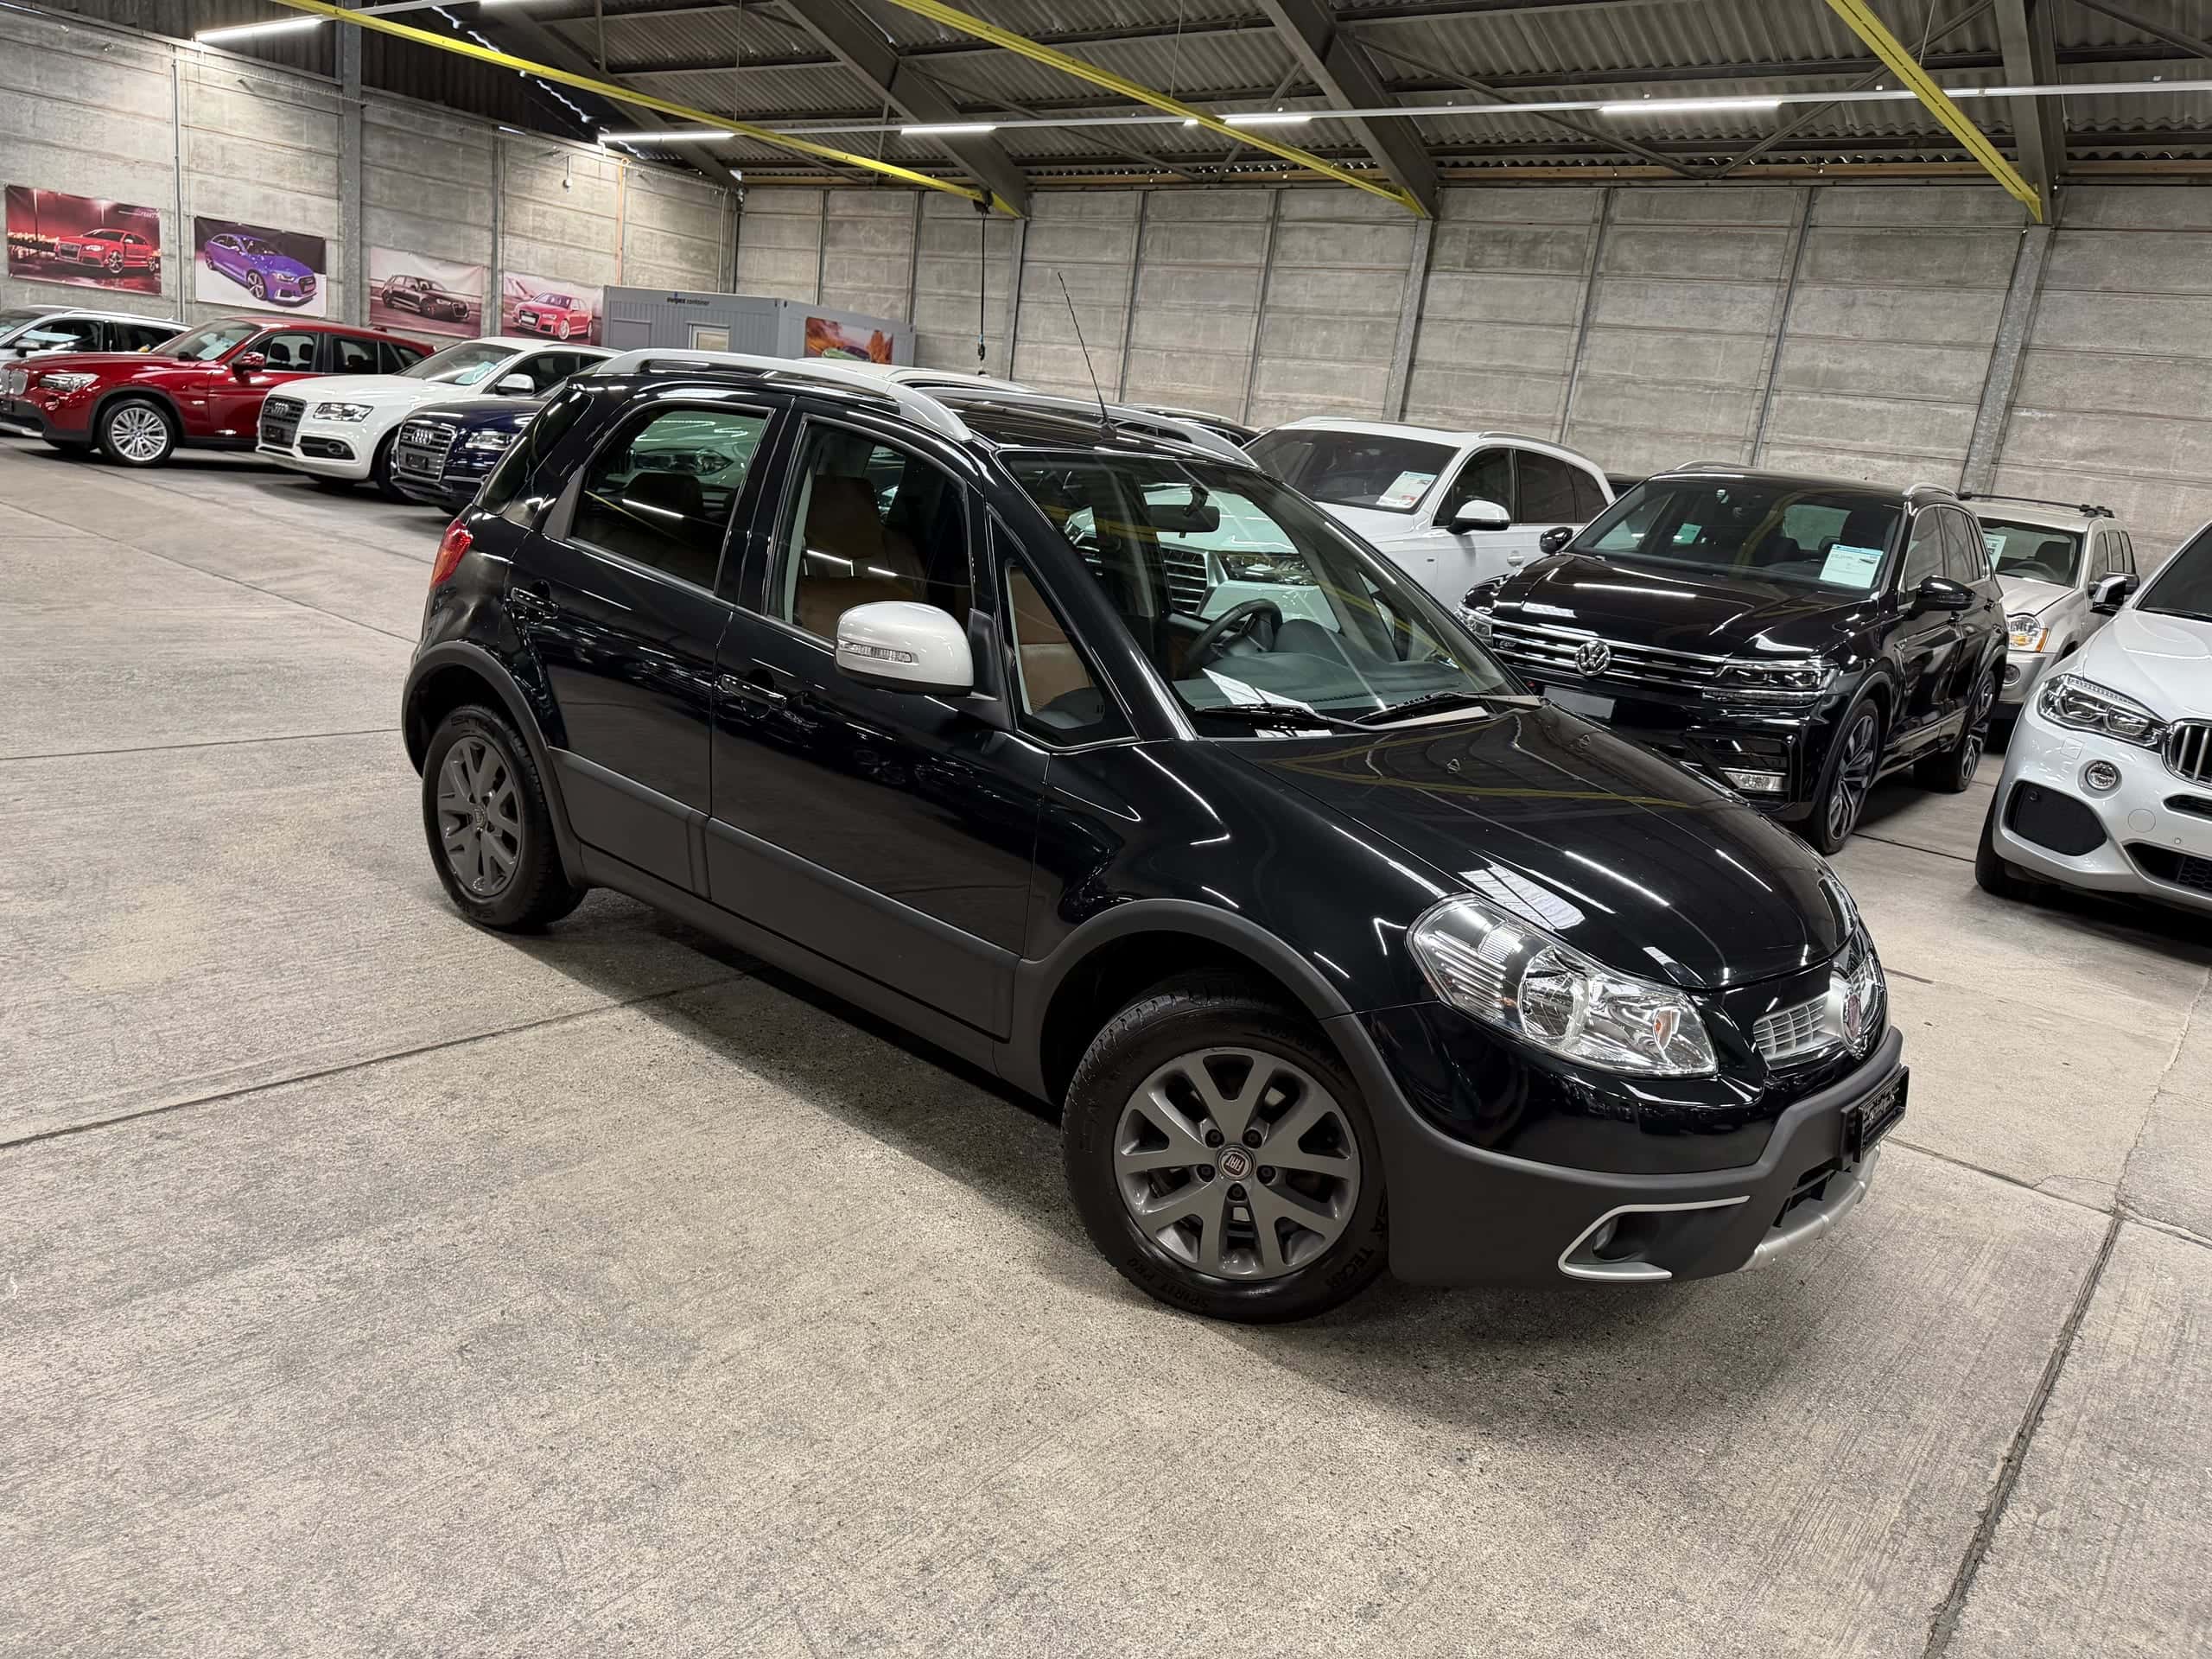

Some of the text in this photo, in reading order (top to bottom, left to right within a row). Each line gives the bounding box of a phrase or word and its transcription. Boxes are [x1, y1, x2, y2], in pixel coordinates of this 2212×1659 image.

[1226, 1154, 1244, 1172] FIAT
[1127, 1257, 1211, 1308] SPIRIT PRO
